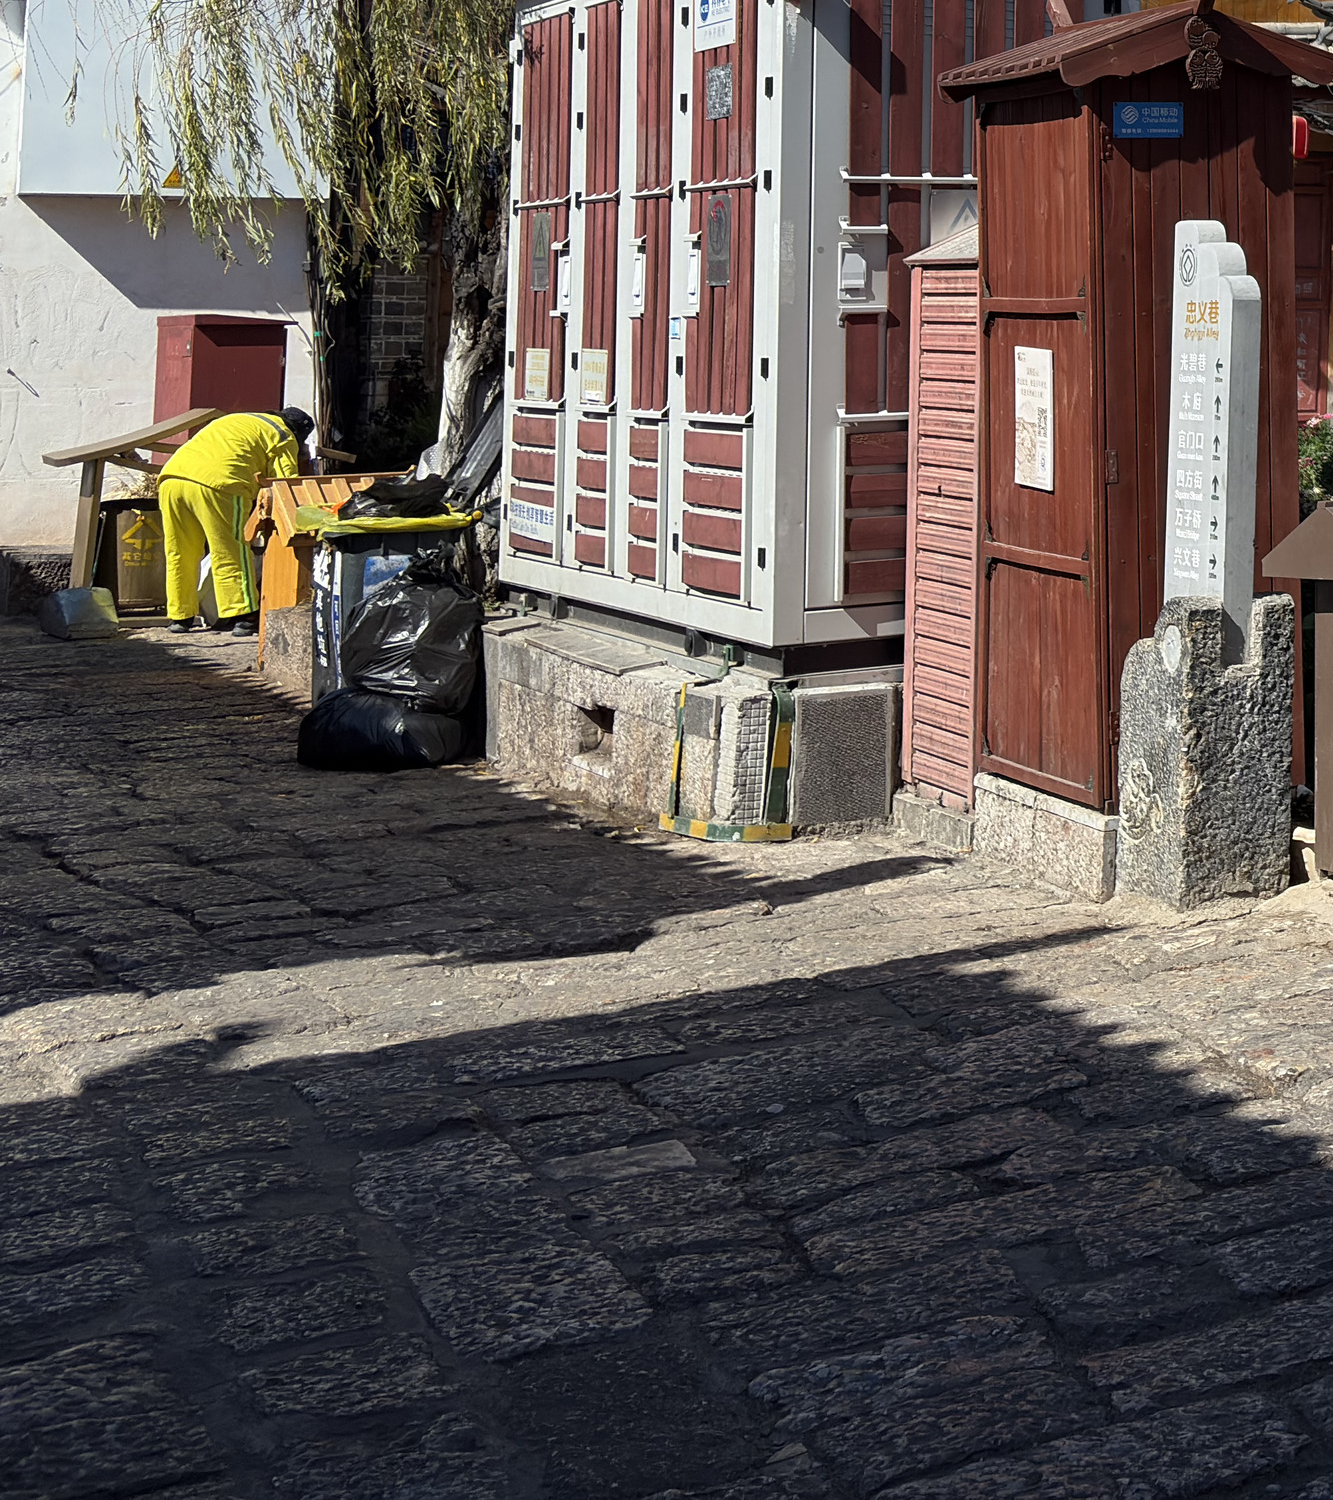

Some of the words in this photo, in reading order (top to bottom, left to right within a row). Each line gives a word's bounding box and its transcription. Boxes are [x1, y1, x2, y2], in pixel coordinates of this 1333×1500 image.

[1141, 107, 1178, 117] 中国移动
[1185, 300, 1219, 325] 忠义巷
[1206, 327, 1220, 341] Alley
[1180, 352, 1206, 371] 光碧巷
[1182, 391, 1202, 410] 木府
[1178, 430, 1204, 449] 官门口
[1176, 469, 1203, 489] 四方街
[1175, 508, 1201, 528] 万子桥
[1173, 546, 1200, 567] 兴文巷
